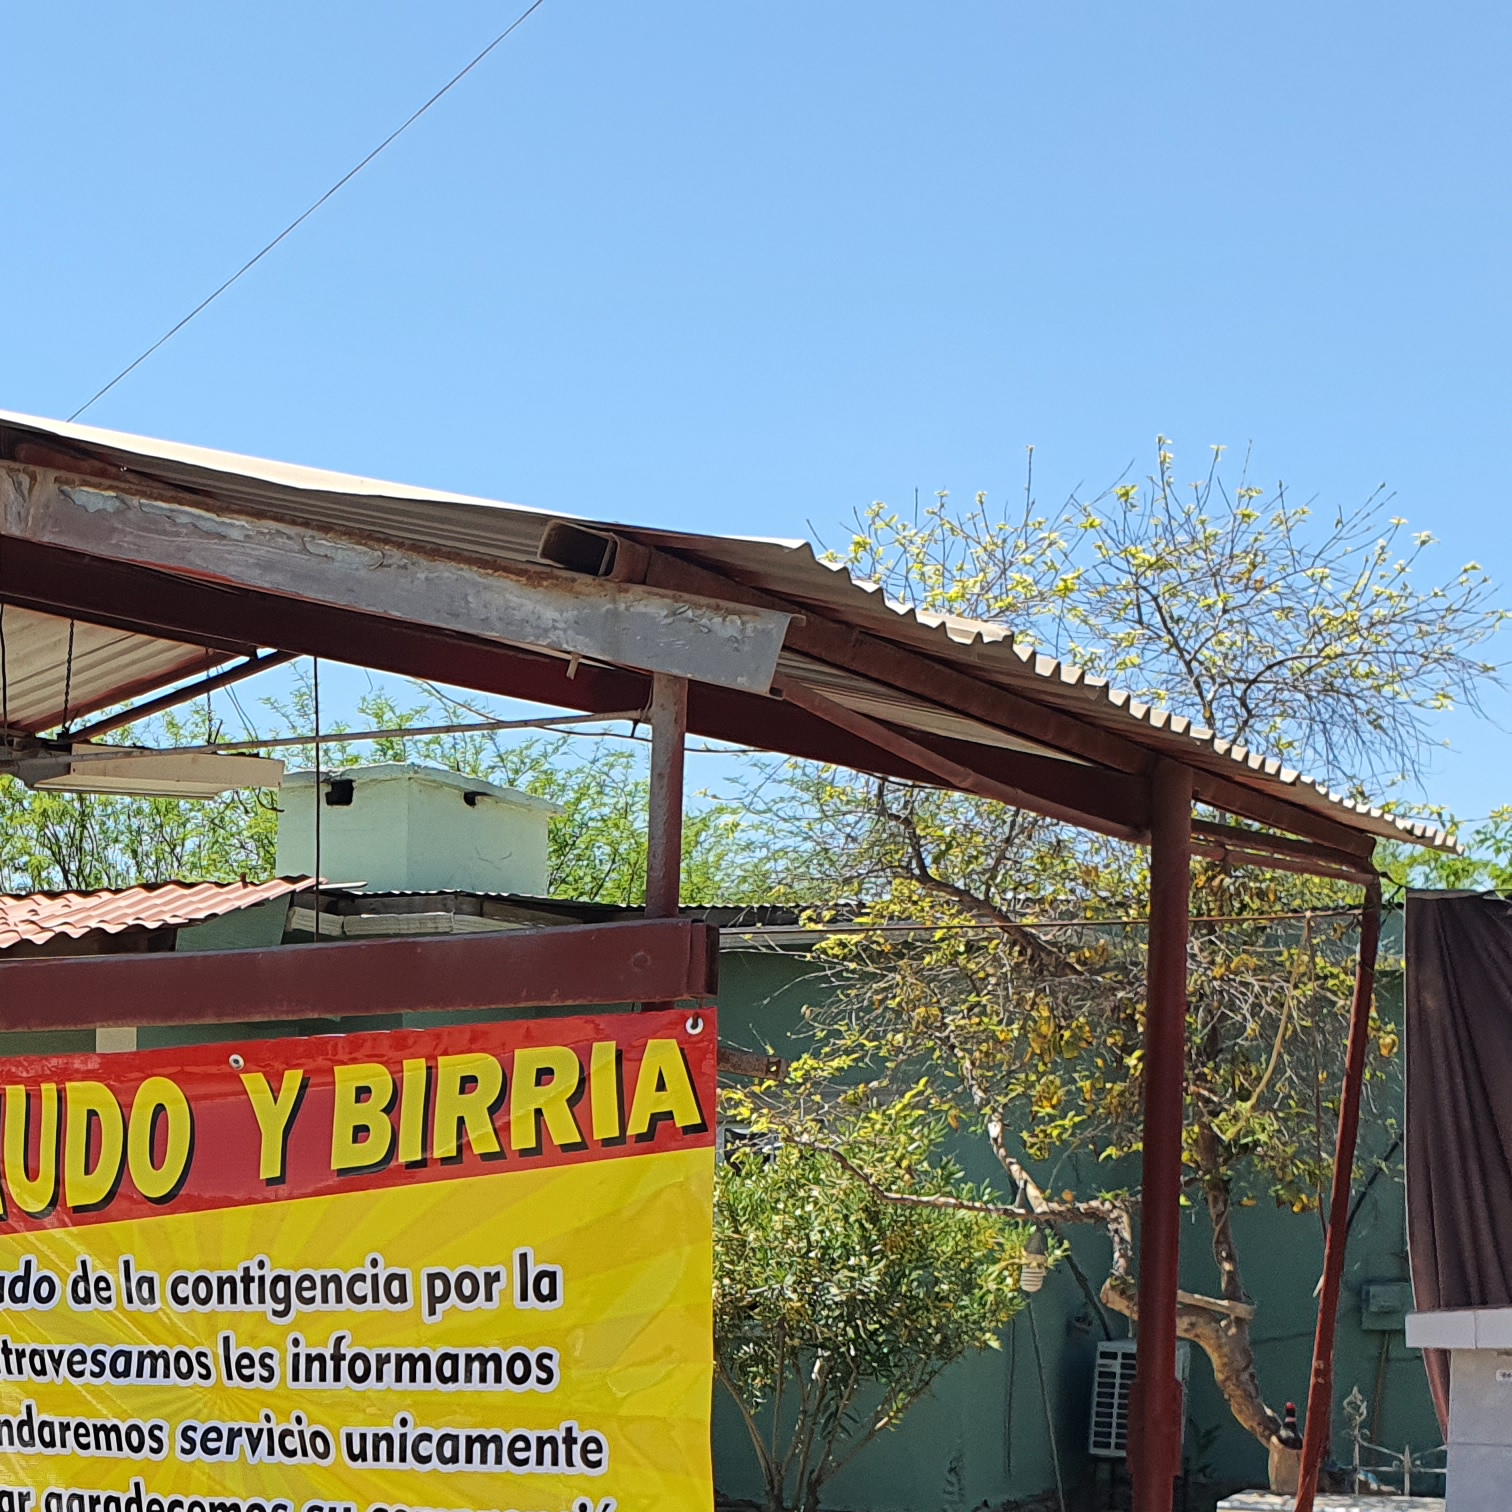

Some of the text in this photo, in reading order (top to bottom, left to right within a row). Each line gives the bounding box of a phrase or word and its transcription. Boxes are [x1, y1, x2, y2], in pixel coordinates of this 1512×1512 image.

[240, 1069, 307, 1183] Y
[330, 1039, 705, 1173] BIRRIA
[70, 1259, 113, 1306] de
[122, 1258, 157, 1306] la
[170, 1256, 408, 1319] contigencia
[425, 1268, 501, 1318] por
[517, 1251, 559, 1304] la
[222, 1334, 275, 1384] les
[290, 1335, 555, 1386] informamos
[179, 1412, 331, 1461] servicio
[345, 1415, 604, 1470] unicamente
